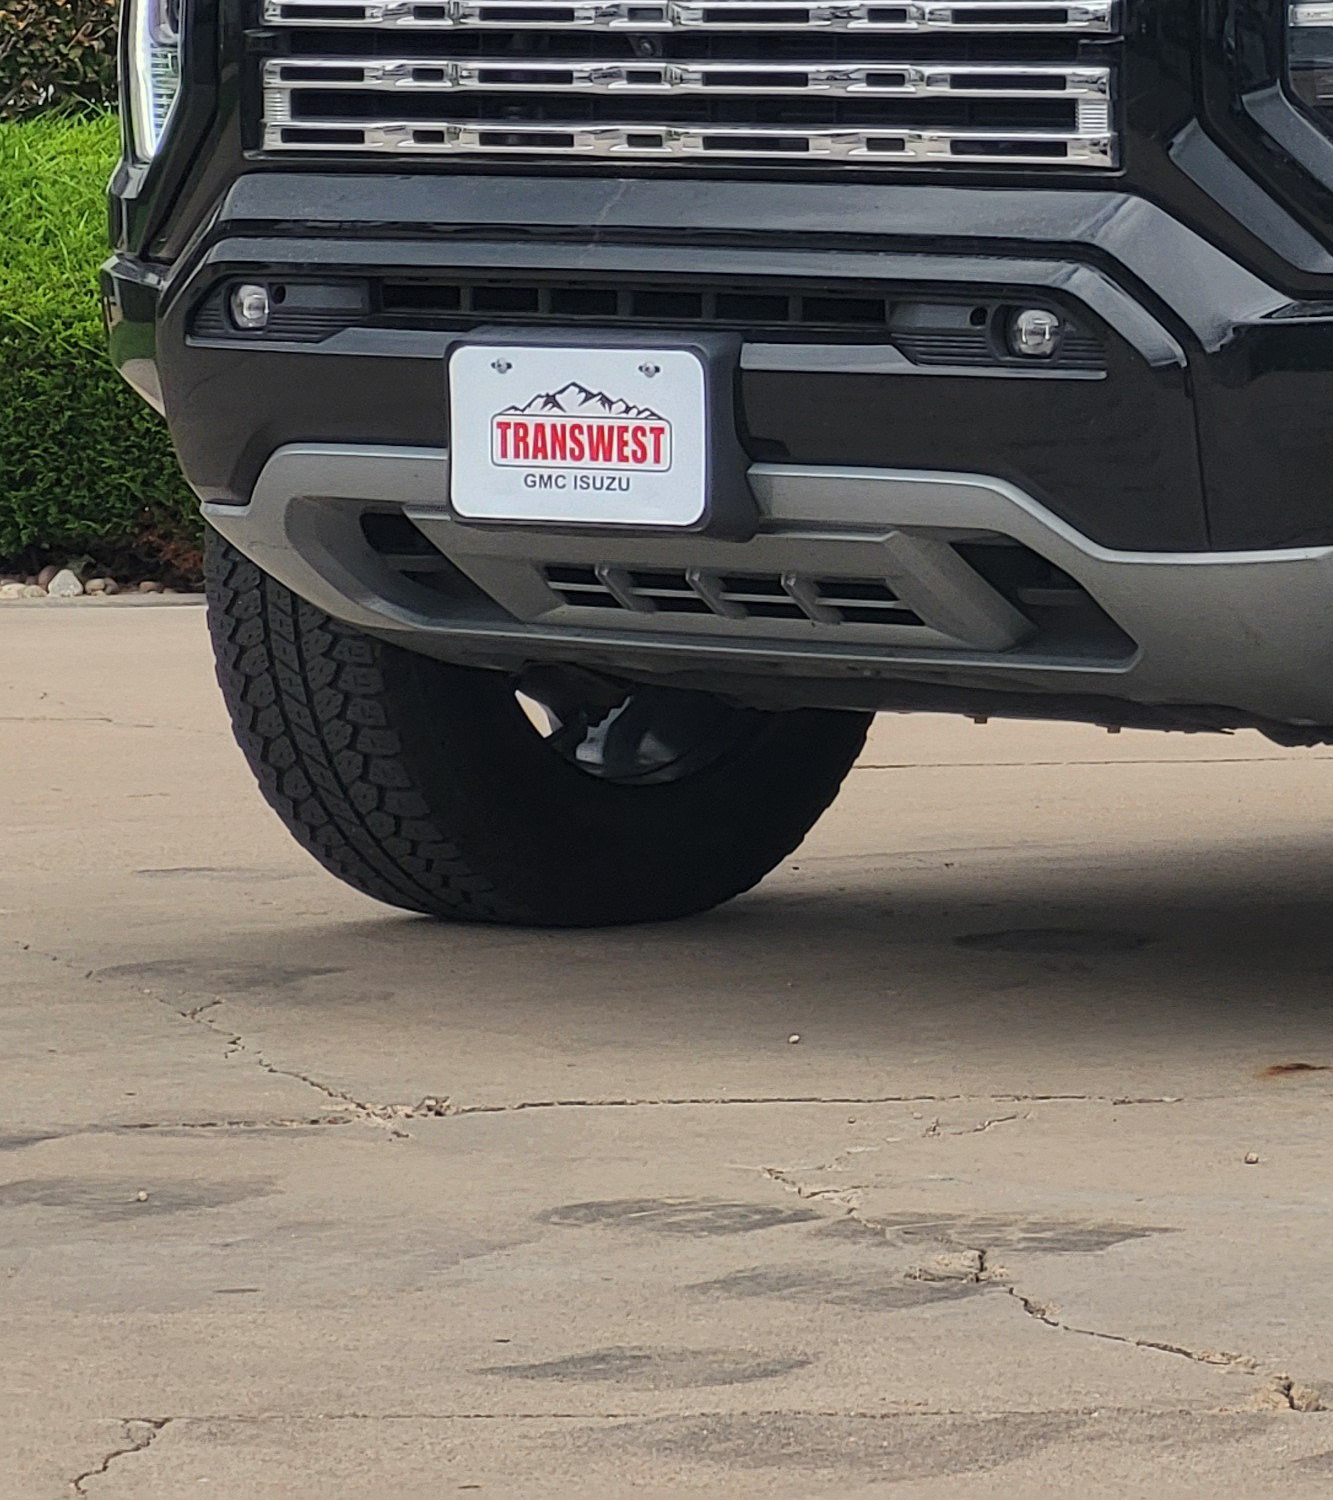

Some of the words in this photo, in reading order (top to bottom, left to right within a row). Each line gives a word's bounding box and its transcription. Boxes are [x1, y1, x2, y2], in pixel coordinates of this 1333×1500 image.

[496, 421, 665, 465] TRANSWEST
[523, 474, 567, 490] GMC
[573, 476, 631, 491] ISUZU
